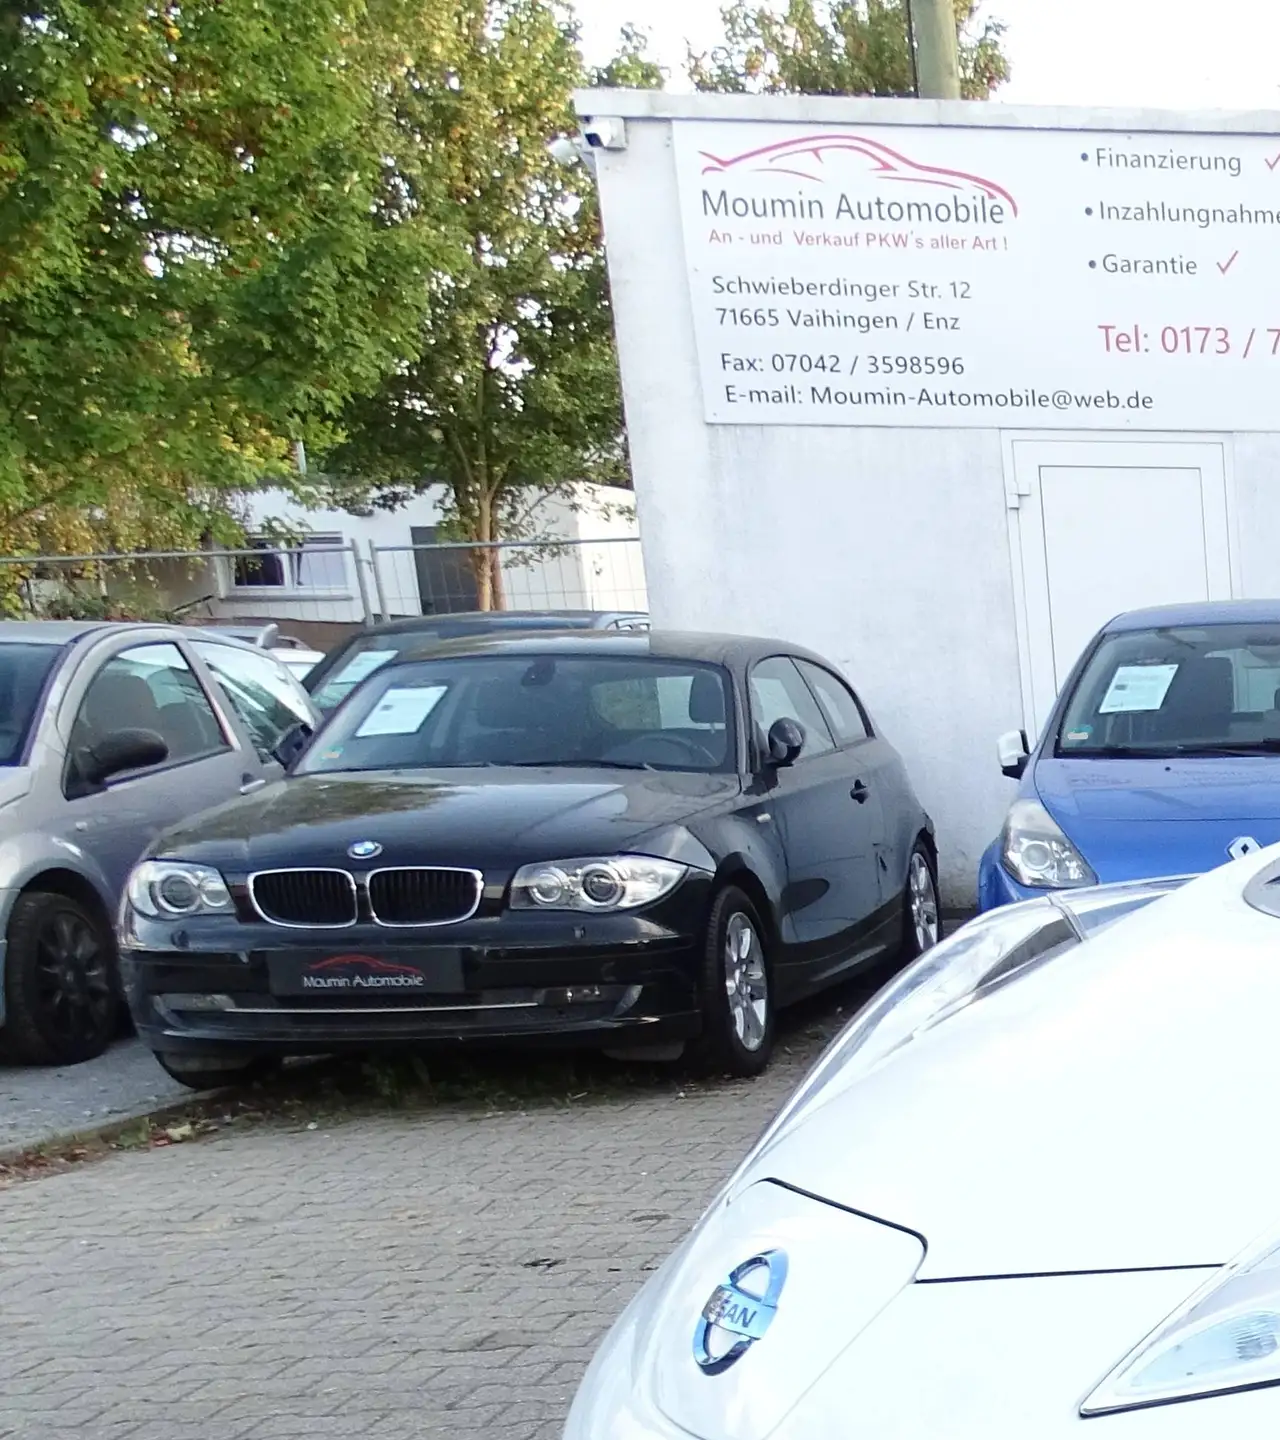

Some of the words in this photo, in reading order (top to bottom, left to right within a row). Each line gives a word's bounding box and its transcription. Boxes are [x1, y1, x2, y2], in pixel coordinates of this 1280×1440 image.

[1096, 148, 1241, 177] Finanzierung
[702, 190, 823, 218] Moumin
[836, 193, 1005, 223] Automobile
[709, 229, 732, 243] An
[751, 231, 782, 245] und
[794, 231, 859, 246] Verkauf
[931, 235, 966, 249] aller
[1103, 254, 1197, 274] Garantie
[713, 276, 899, 302] Schwieberdinger
[908, 280, 941, 298] Str.
[950, 282, 971, 298] 12
[716, 308, 779, 326] 71665
[787, 310, 897, 333] Vaihingen
[924, 312, 960, 329] Enz
[1098, 325, 1149, 352] Tel:
[1162, 326, 1230, 354] 0173
[721, 353, 763, 371] Fax:
[772, 354, 840, 372] 07042
[868, 356, 964, 375] 3598596
[726, 385, 802, 403] E-mail:
[811, 387, 1153, 409] Moumin-Automobile@web.de
[303, 975, 351, 987] Moumin
[353, 973, 424, 987] Automobile
